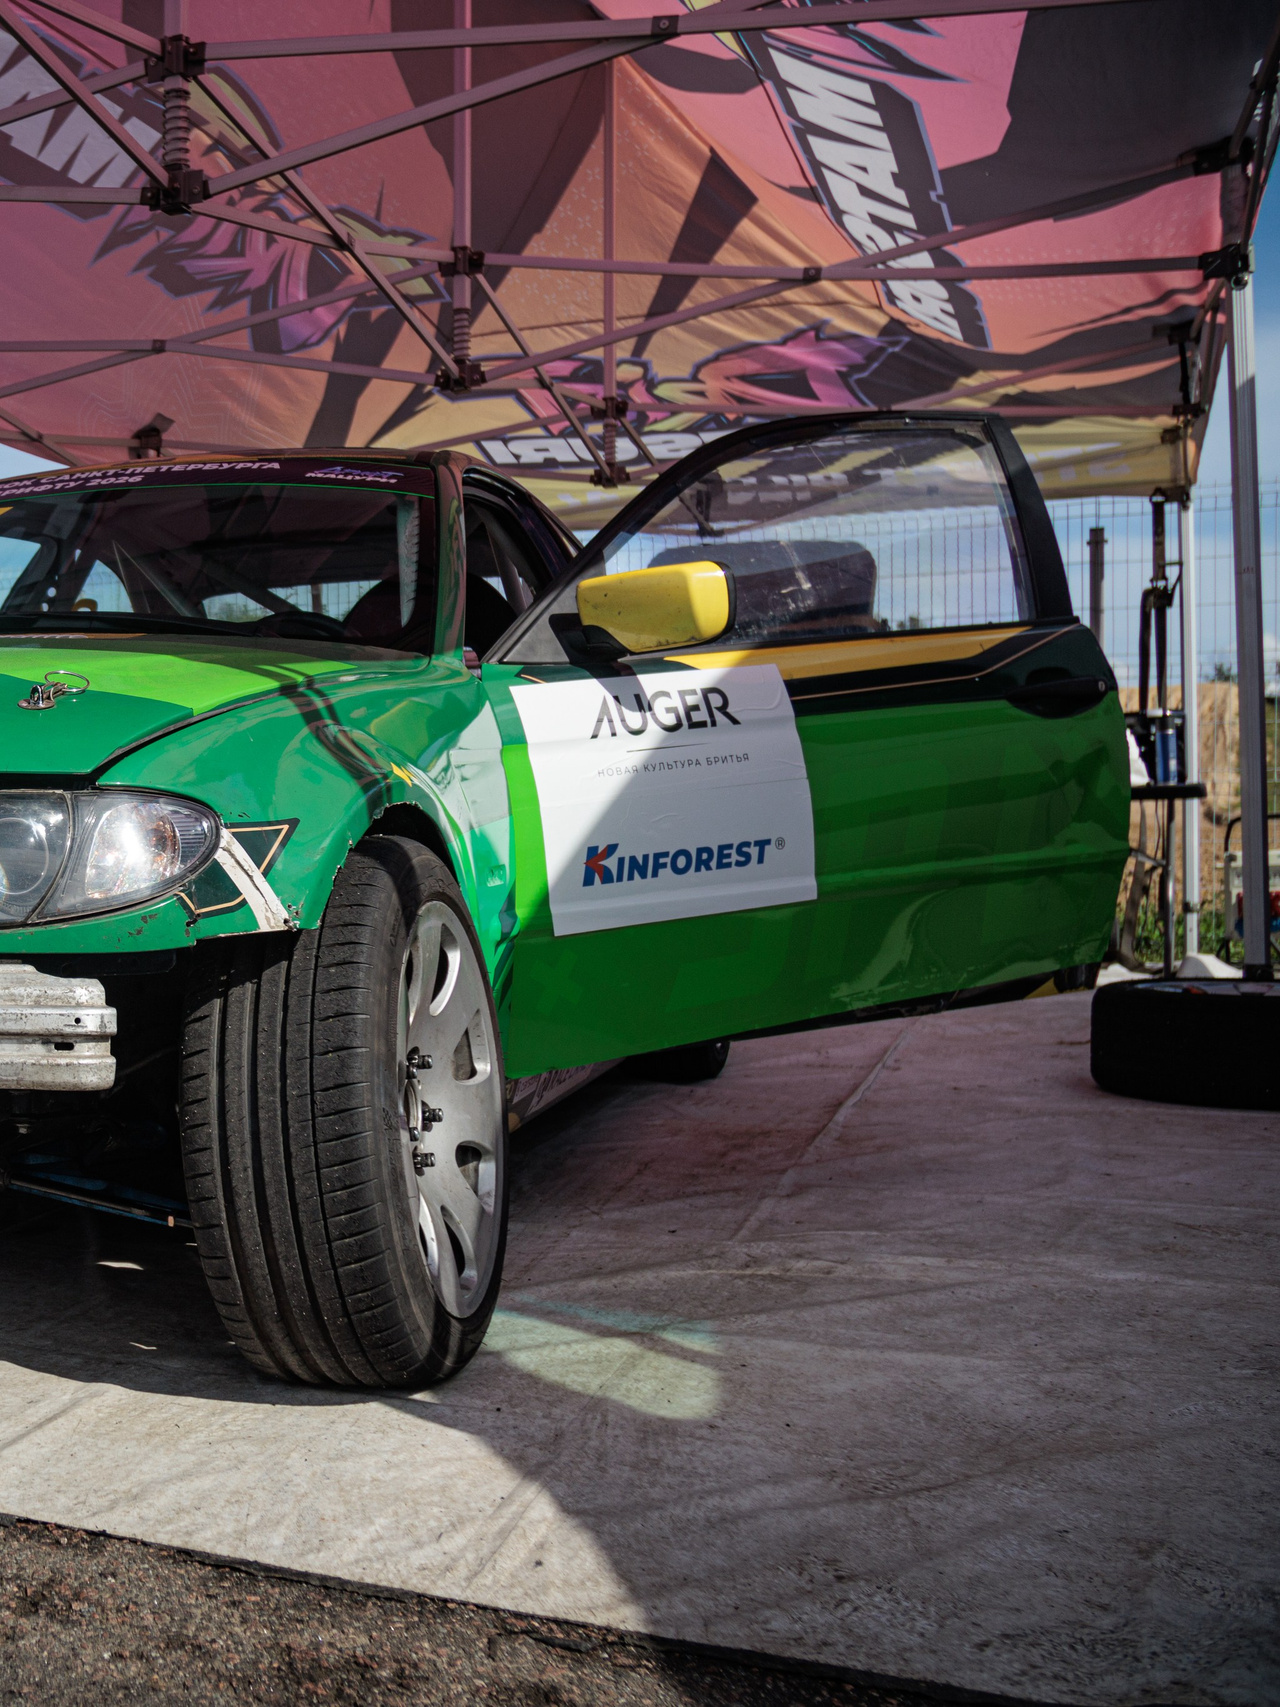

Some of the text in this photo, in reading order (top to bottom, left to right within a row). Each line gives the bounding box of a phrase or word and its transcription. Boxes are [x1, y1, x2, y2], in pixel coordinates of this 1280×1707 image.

[38, 462, 281, 482] САНКТ-ПЕТЕРБУРГА
[84, 475, 145, 486] 2026
[589, 686, 742, 740] AUGER
[597, 752, 751, 778] НОВАЯ КУЛЬТУРА БРИТЬЯ
[582, 838, 772, 888] KINFOREST
